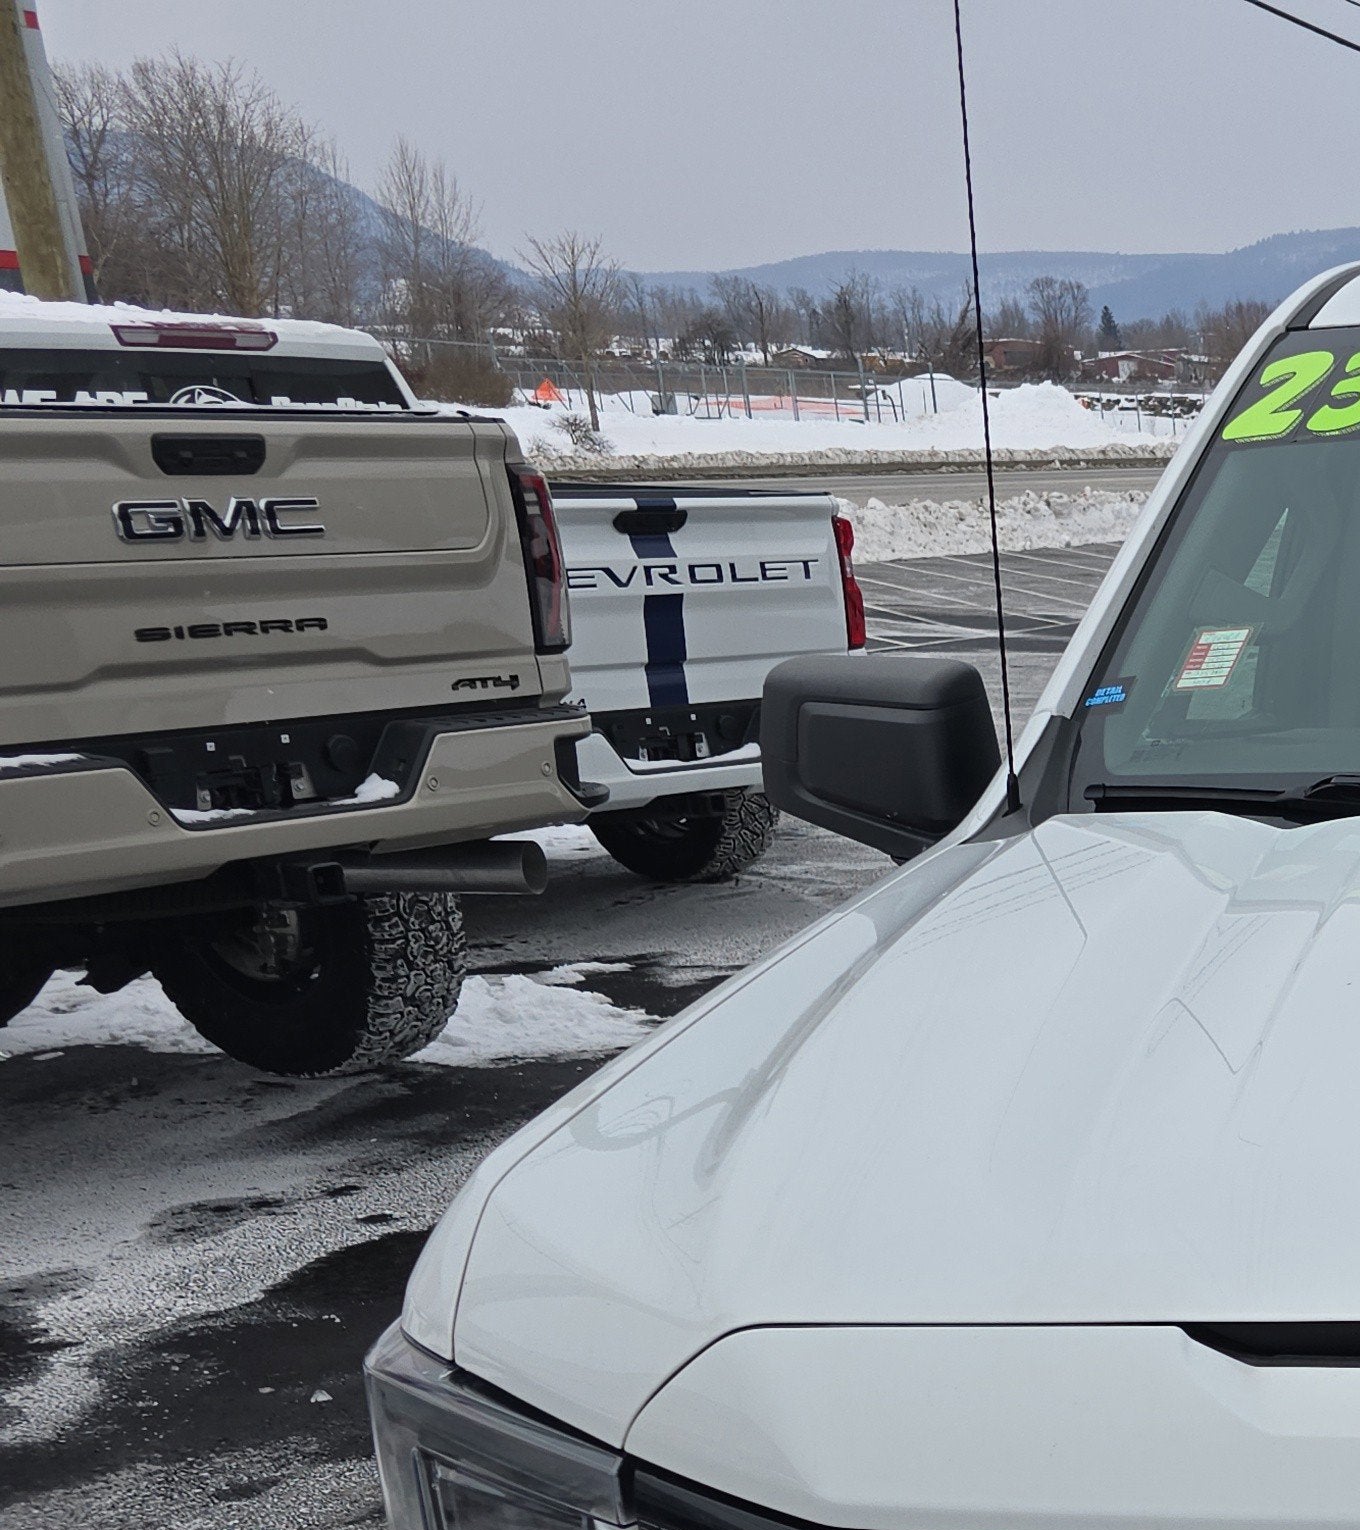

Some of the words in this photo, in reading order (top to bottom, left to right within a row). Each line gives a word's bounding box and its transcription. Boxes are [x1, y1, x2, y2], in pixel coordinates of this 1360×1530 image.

[112, 497, 326, 544] GMC
[566, 559, 818, 588] EVROLET
[134, 617, 328, 643] SIERRA
[451, 674, 520, 691] AT4
